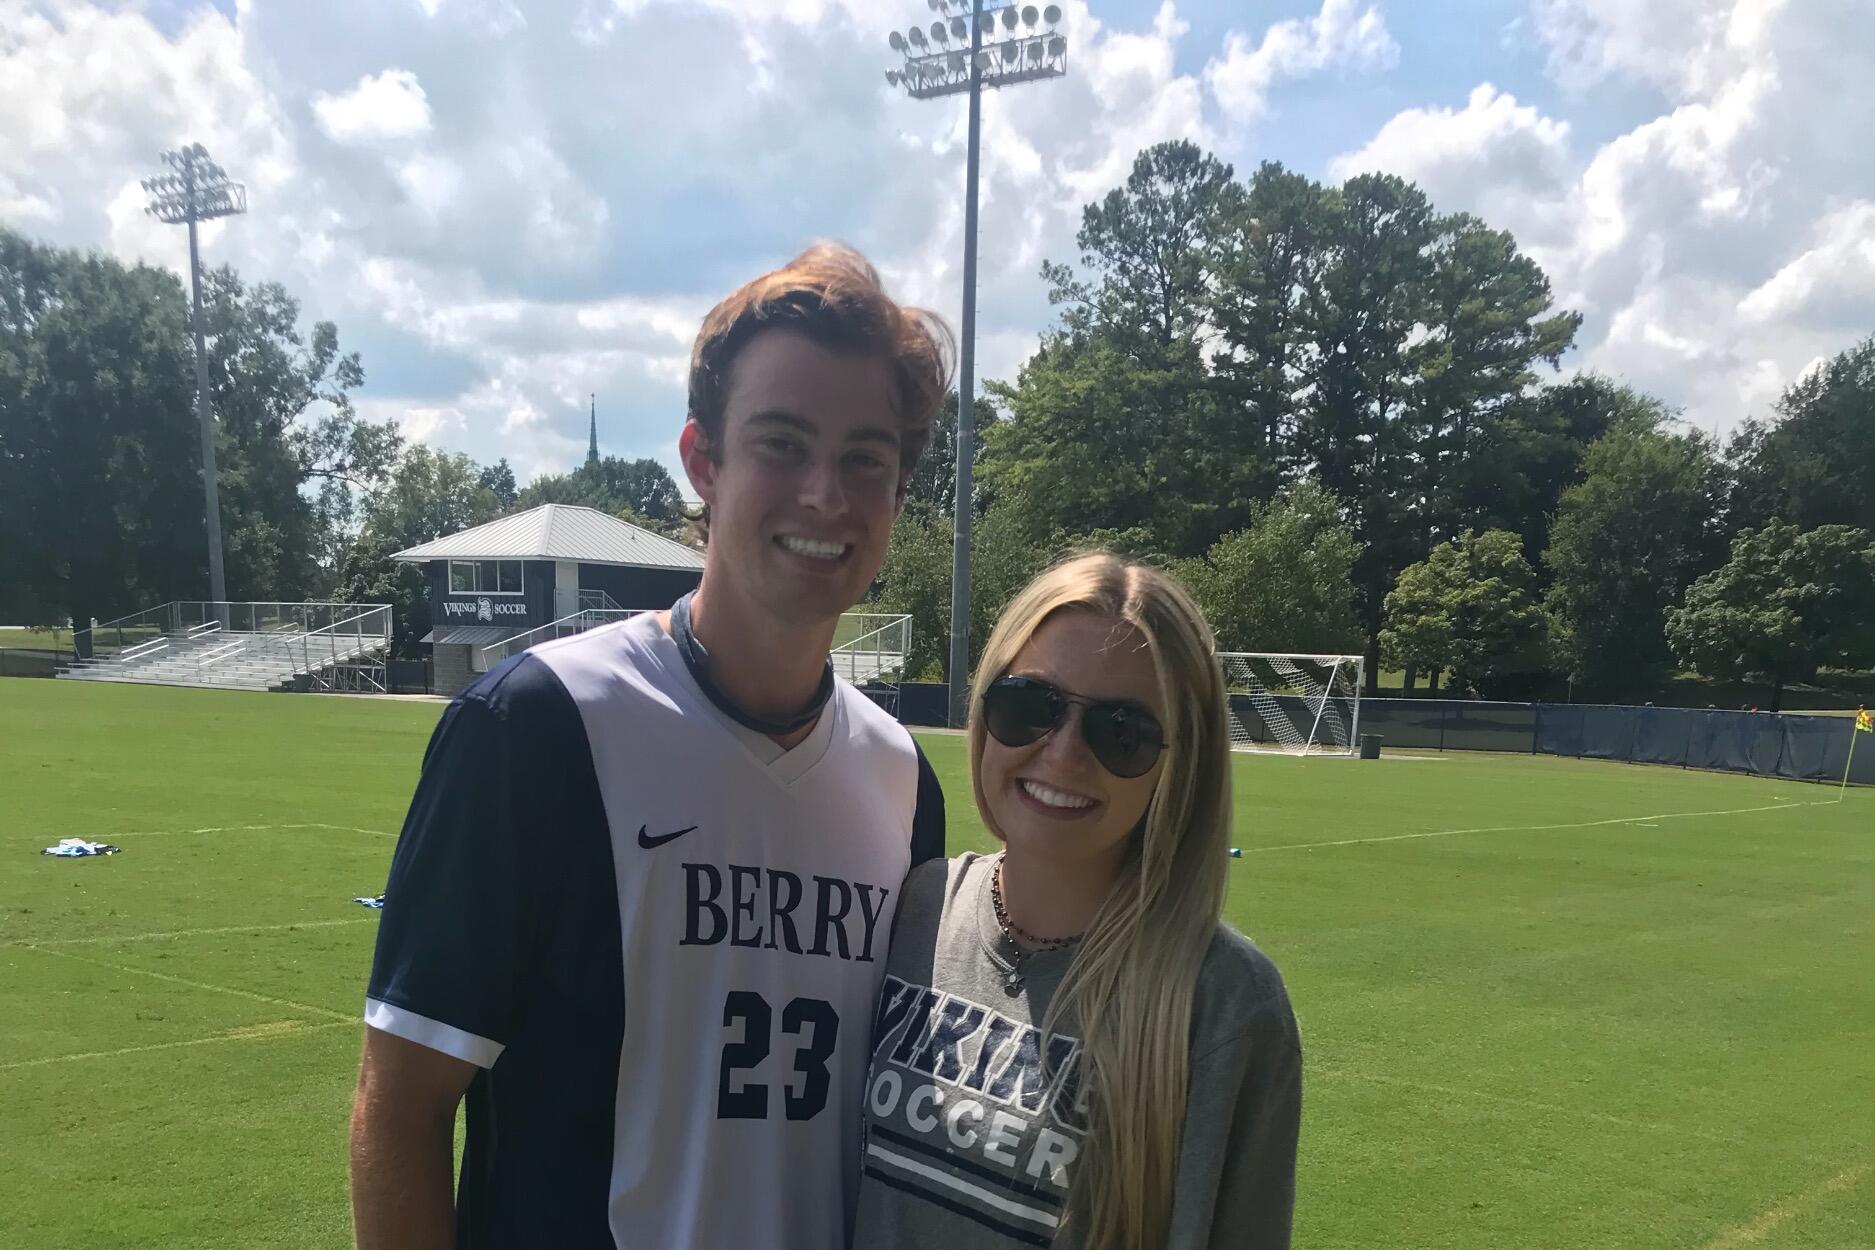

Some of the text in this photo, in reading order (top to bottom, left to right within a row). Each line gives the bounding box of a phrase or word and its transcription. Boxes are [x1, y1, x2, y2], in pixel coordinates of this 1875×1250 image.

[443, 602, 527, 616] VIKINGS SOCCER
[680, 862, 889, 962] BERRY
[717, 990, 840, 1121] 23
[865, 1065, 1079, 1188] OCCER
